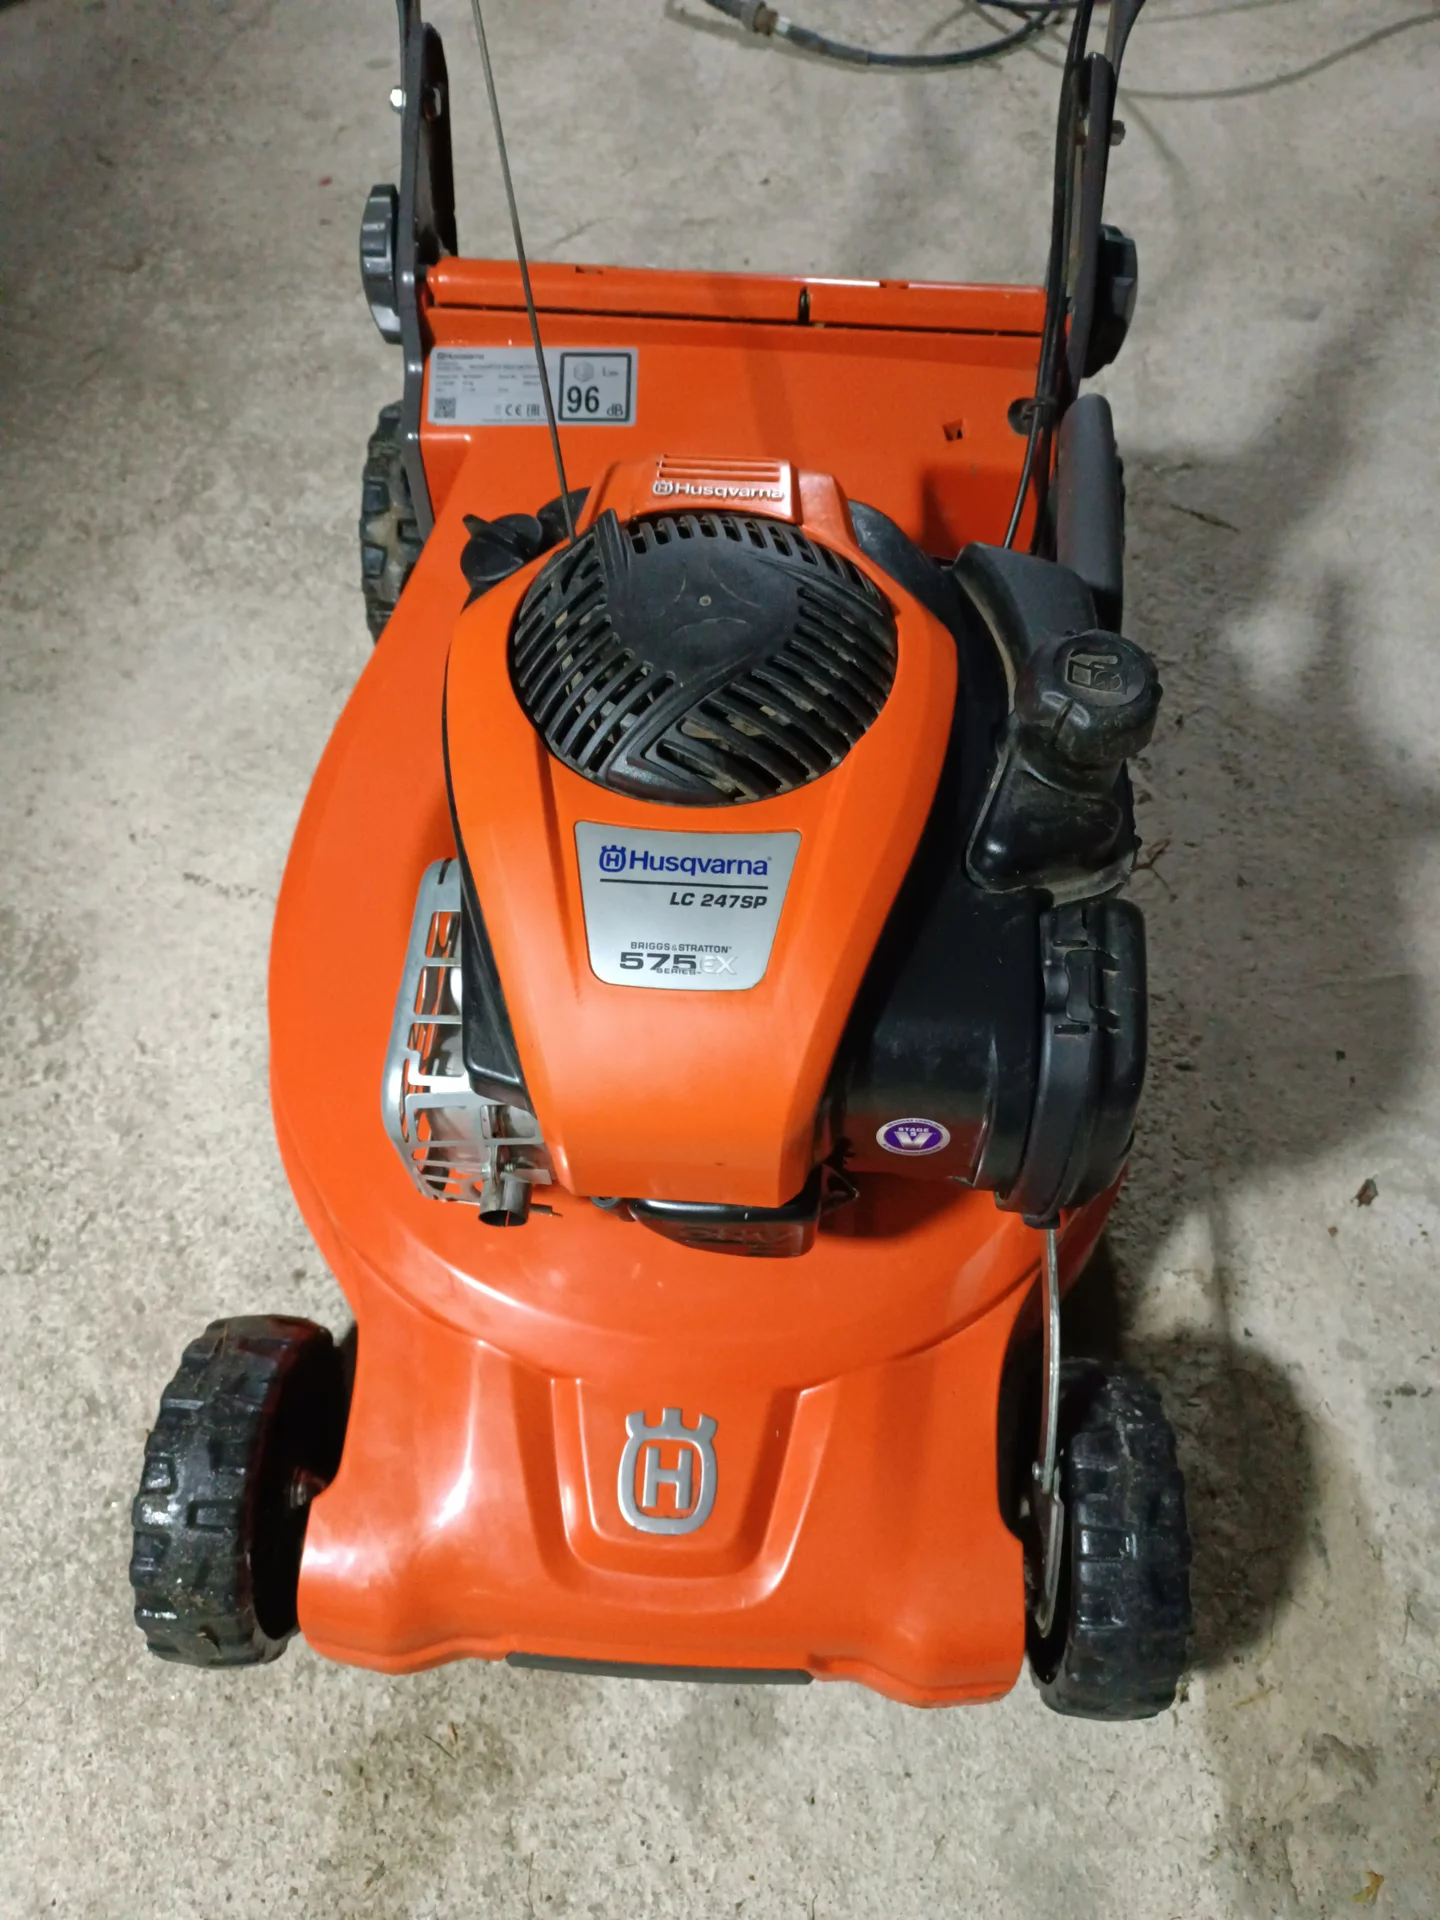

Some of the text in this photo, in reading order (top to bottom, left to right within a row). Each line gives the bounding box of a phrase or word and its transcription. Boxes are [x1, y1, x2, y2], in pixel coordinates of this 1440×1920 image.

[567, 386, 600, 413] 96
[606, 403, 624, 417] dB
[674, 482, 785, 499] Husqvarna
[629, 850, 768, 876] Husqvarna
[669, 892, 768, 909] LC 247SP
[894, 1131, 933, 1149] V
